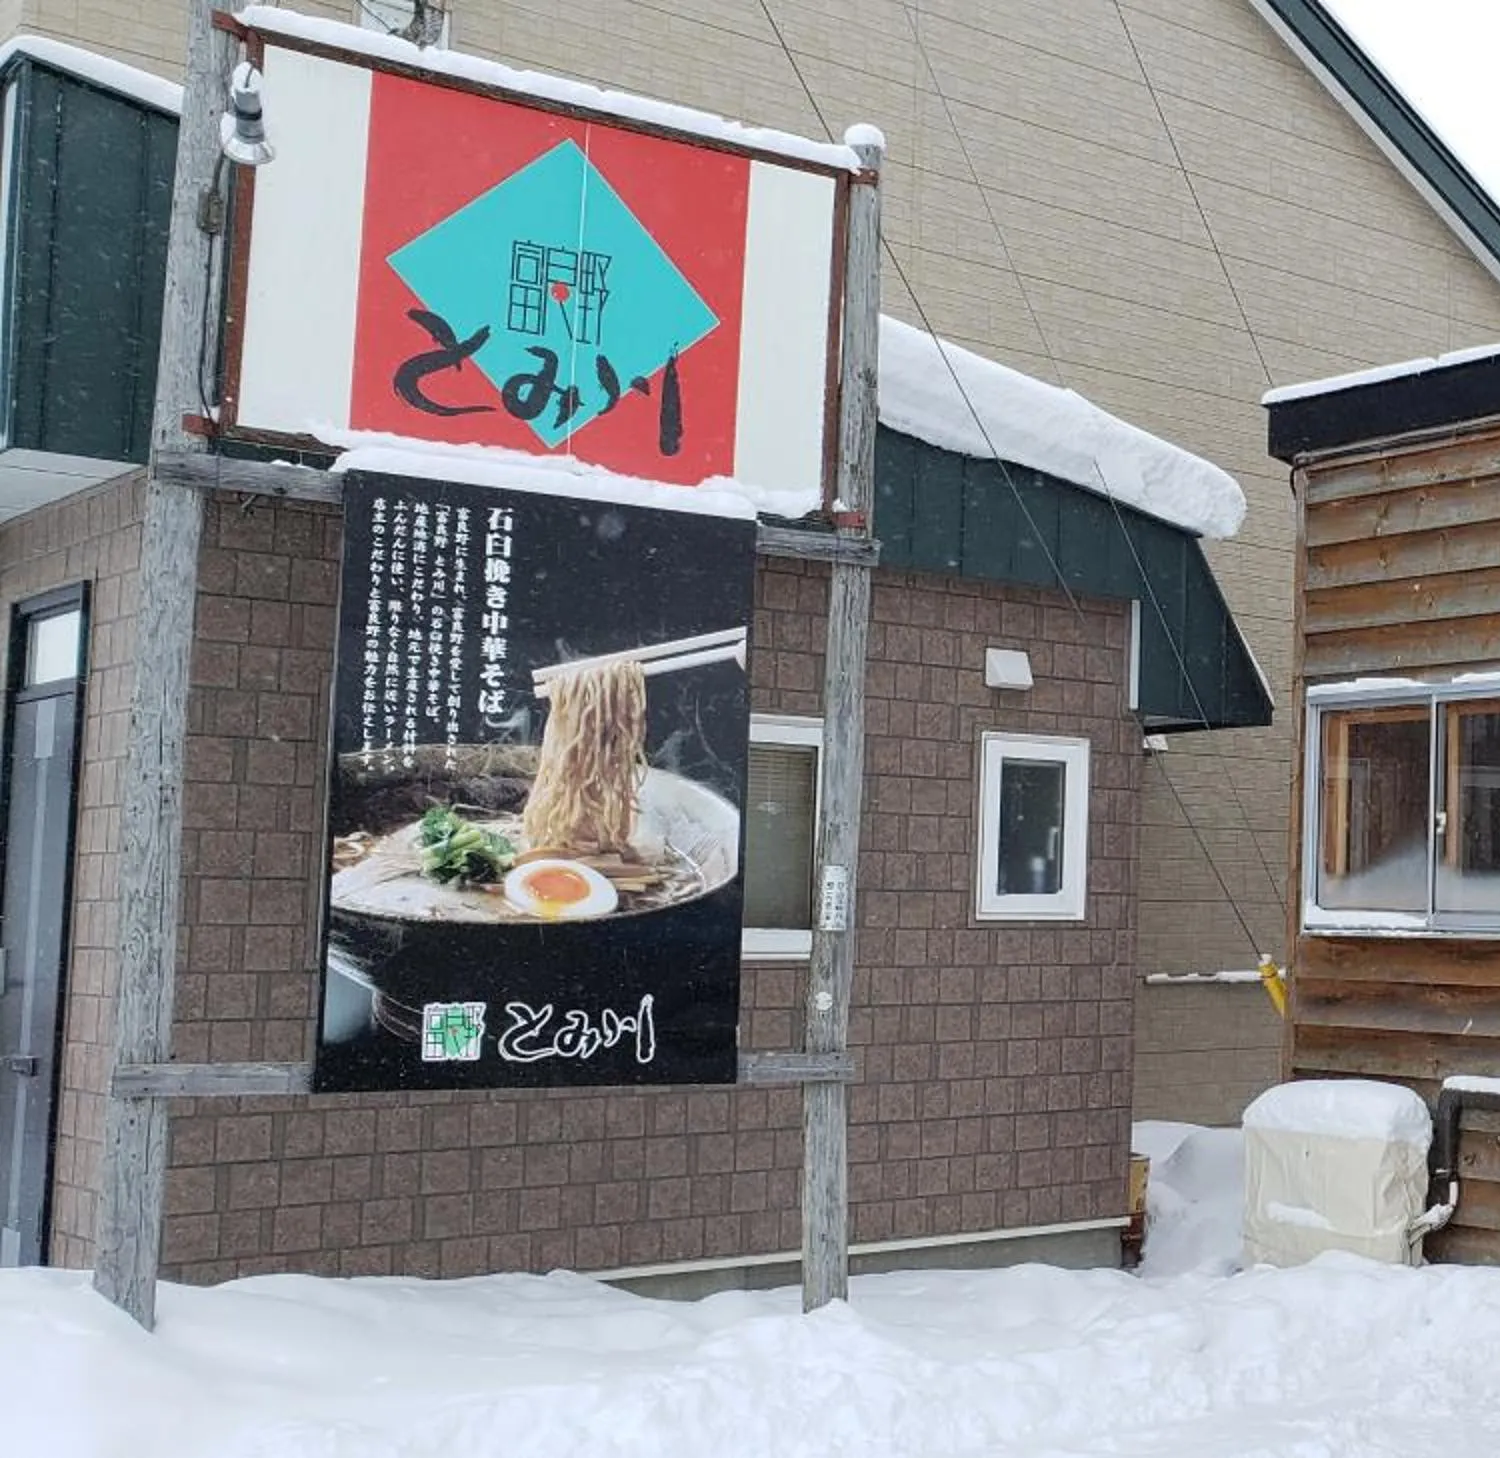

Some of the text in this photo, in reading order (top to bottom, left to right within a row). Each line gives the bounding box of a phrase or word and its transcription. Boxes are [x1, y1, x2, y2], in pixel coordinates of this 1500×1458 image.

[393, 306, 685, 457] とみ川
[477, 507, 515, 713] 石臼挽き中華そば
[498, 993, 656, 1064] とみ川
